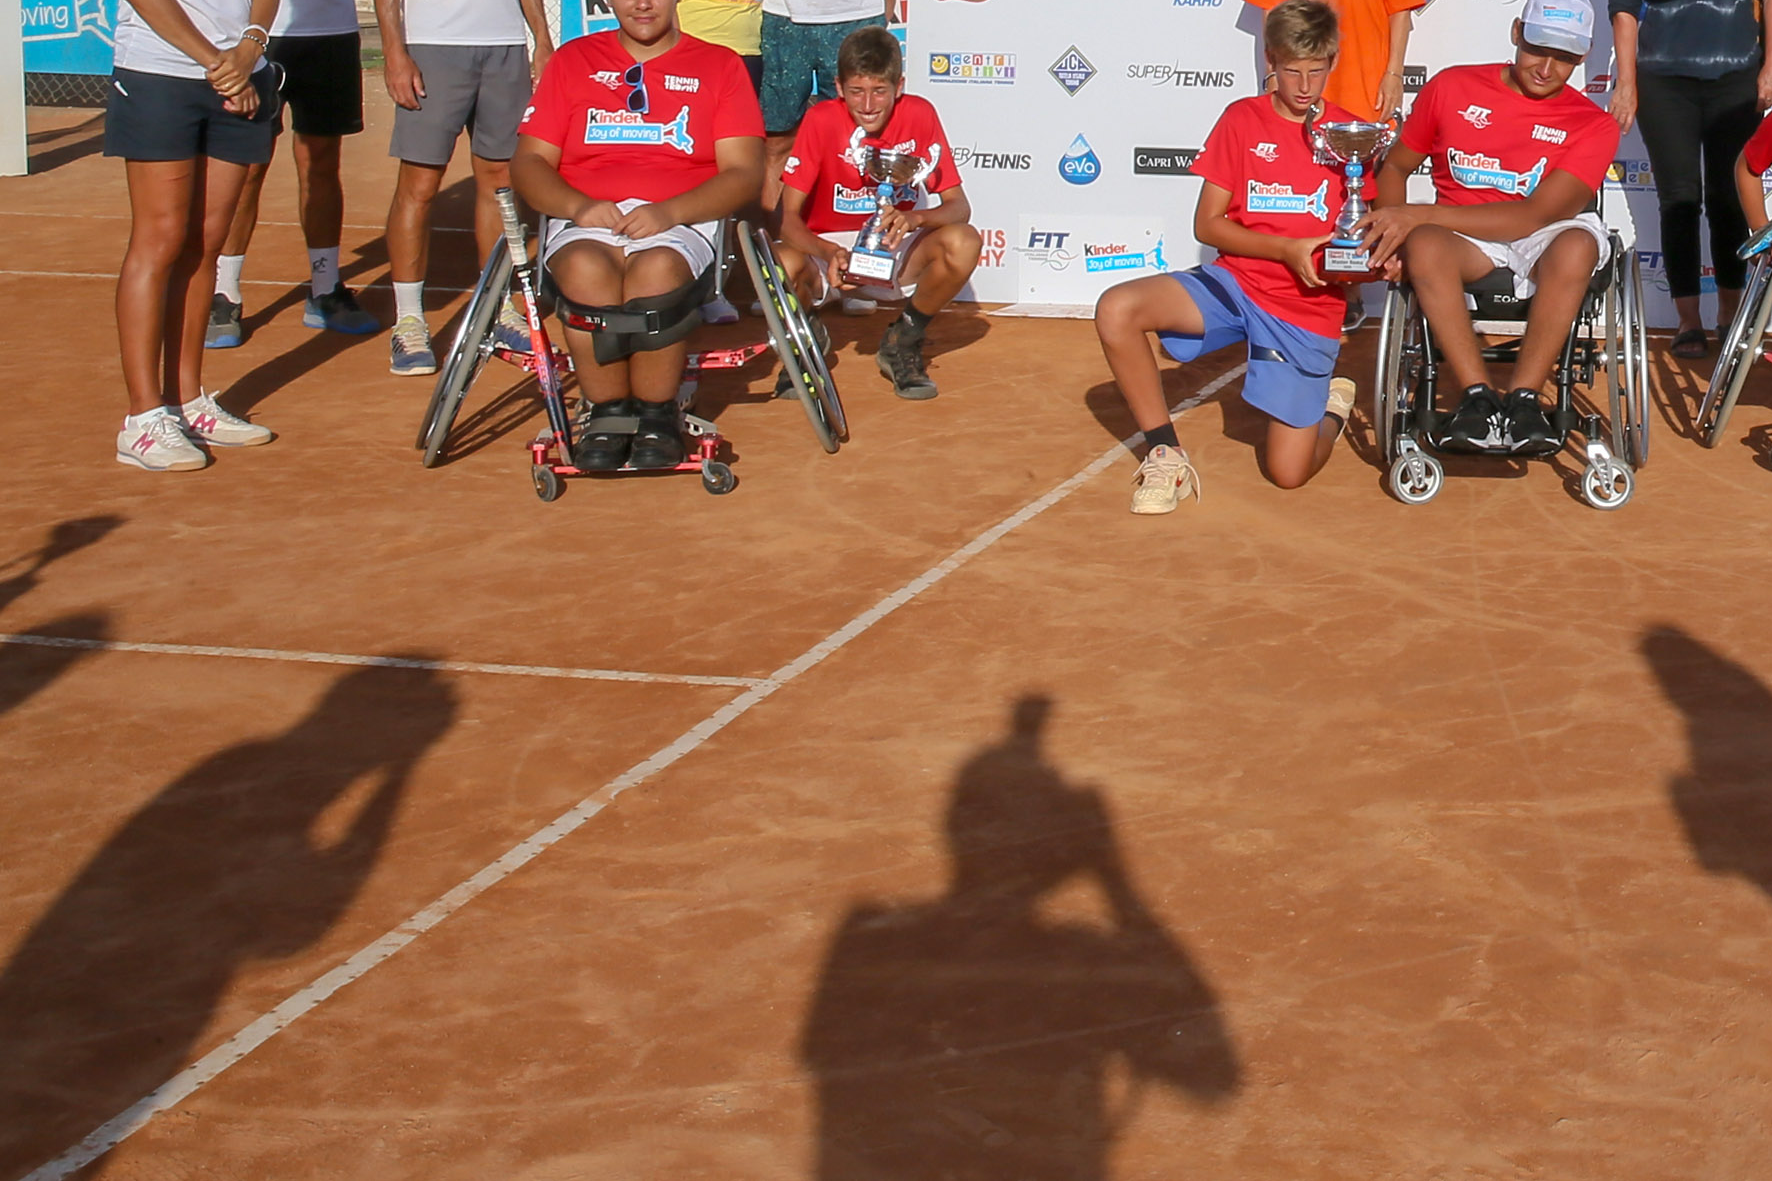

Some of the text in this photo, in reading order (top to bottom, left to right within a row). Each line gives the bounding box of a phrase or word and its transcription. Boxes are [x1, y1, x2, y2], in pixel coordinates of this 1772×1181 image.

[596, 70, 621, 81] FIT
[664, 74, 700, 85] TENNIS
[1403, 74, 1425, 86] TCH
[664, 82, 699, 93] TROPHY
[1467, 104, 1492, 119] FIT
[589, 127, 659, 141] Joy of moving
[1531, 131, 1566, 145] TROPHY
[1533, 123, 1567, 139] TENNIS
[1256, 142, 1278, 153] FIT
[973, 152, 1032, 170] TENNIS
[1136, 154, 1171, 168] CAPRI
[1250, 197, 1304, 209] Joy of moving
[1028, 232, 1070, 249] FIT
[1088, 255, 1143, 270] Joy of moving
[521, 277, 541, 331] HEAD
